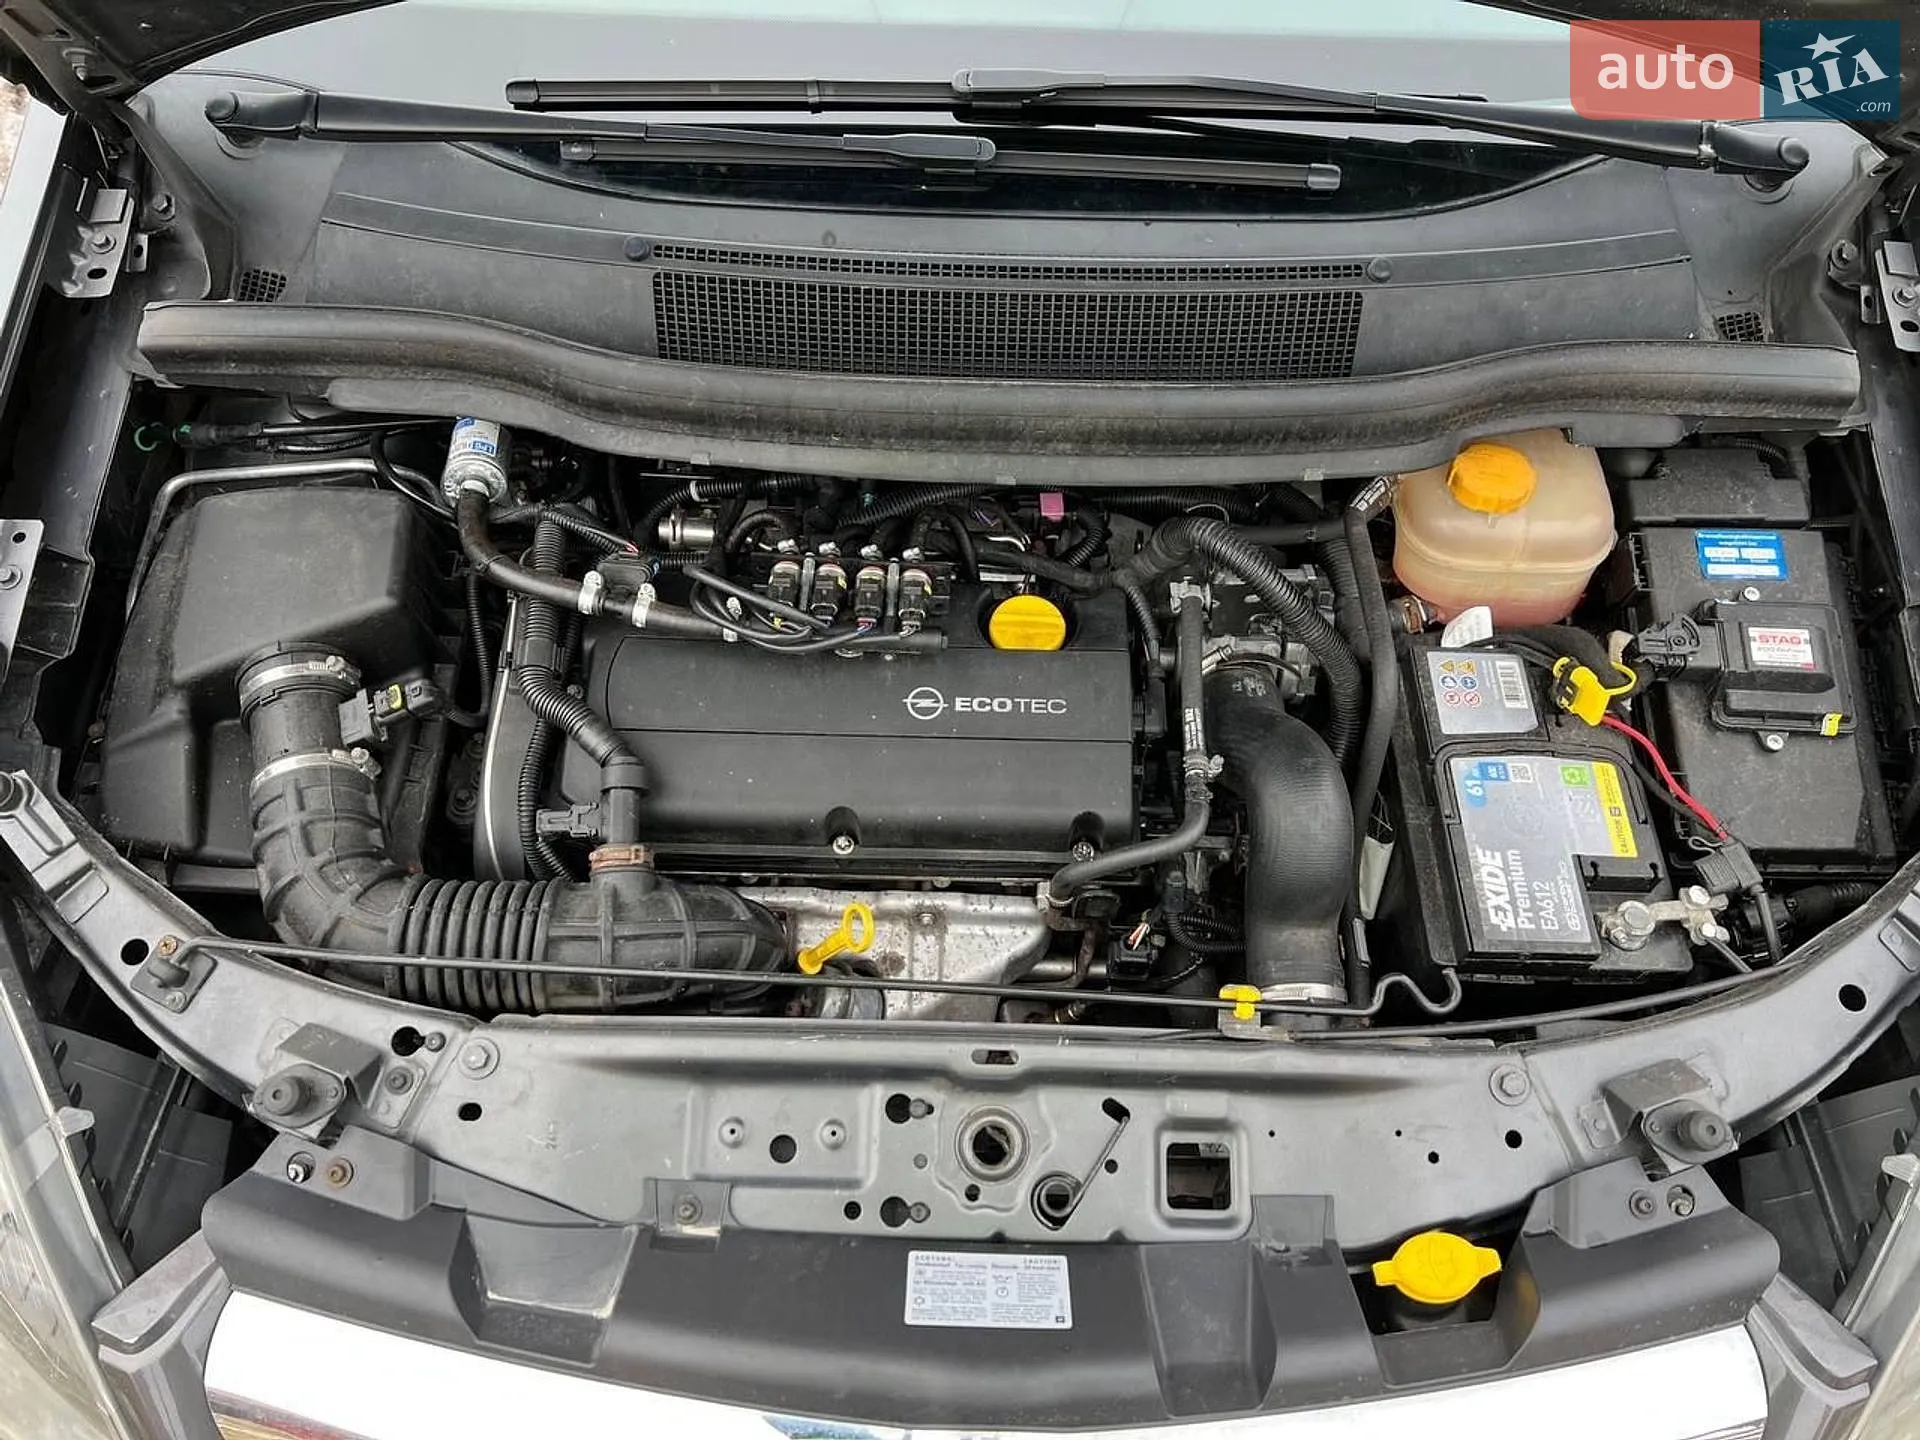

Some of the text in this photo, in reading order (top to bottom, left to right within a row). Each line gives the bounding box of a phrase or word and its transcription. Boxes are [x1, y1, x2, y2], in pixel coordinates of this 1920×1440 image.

[955, 697, 1068, 714] ECOTEC
[1465, 778, 1484, 797] 61
[1475, 847, 1515, 932] EXIDE
[1507, 849, 1536, 930] Premium
[1534, 881, 1560, 931] EA612
